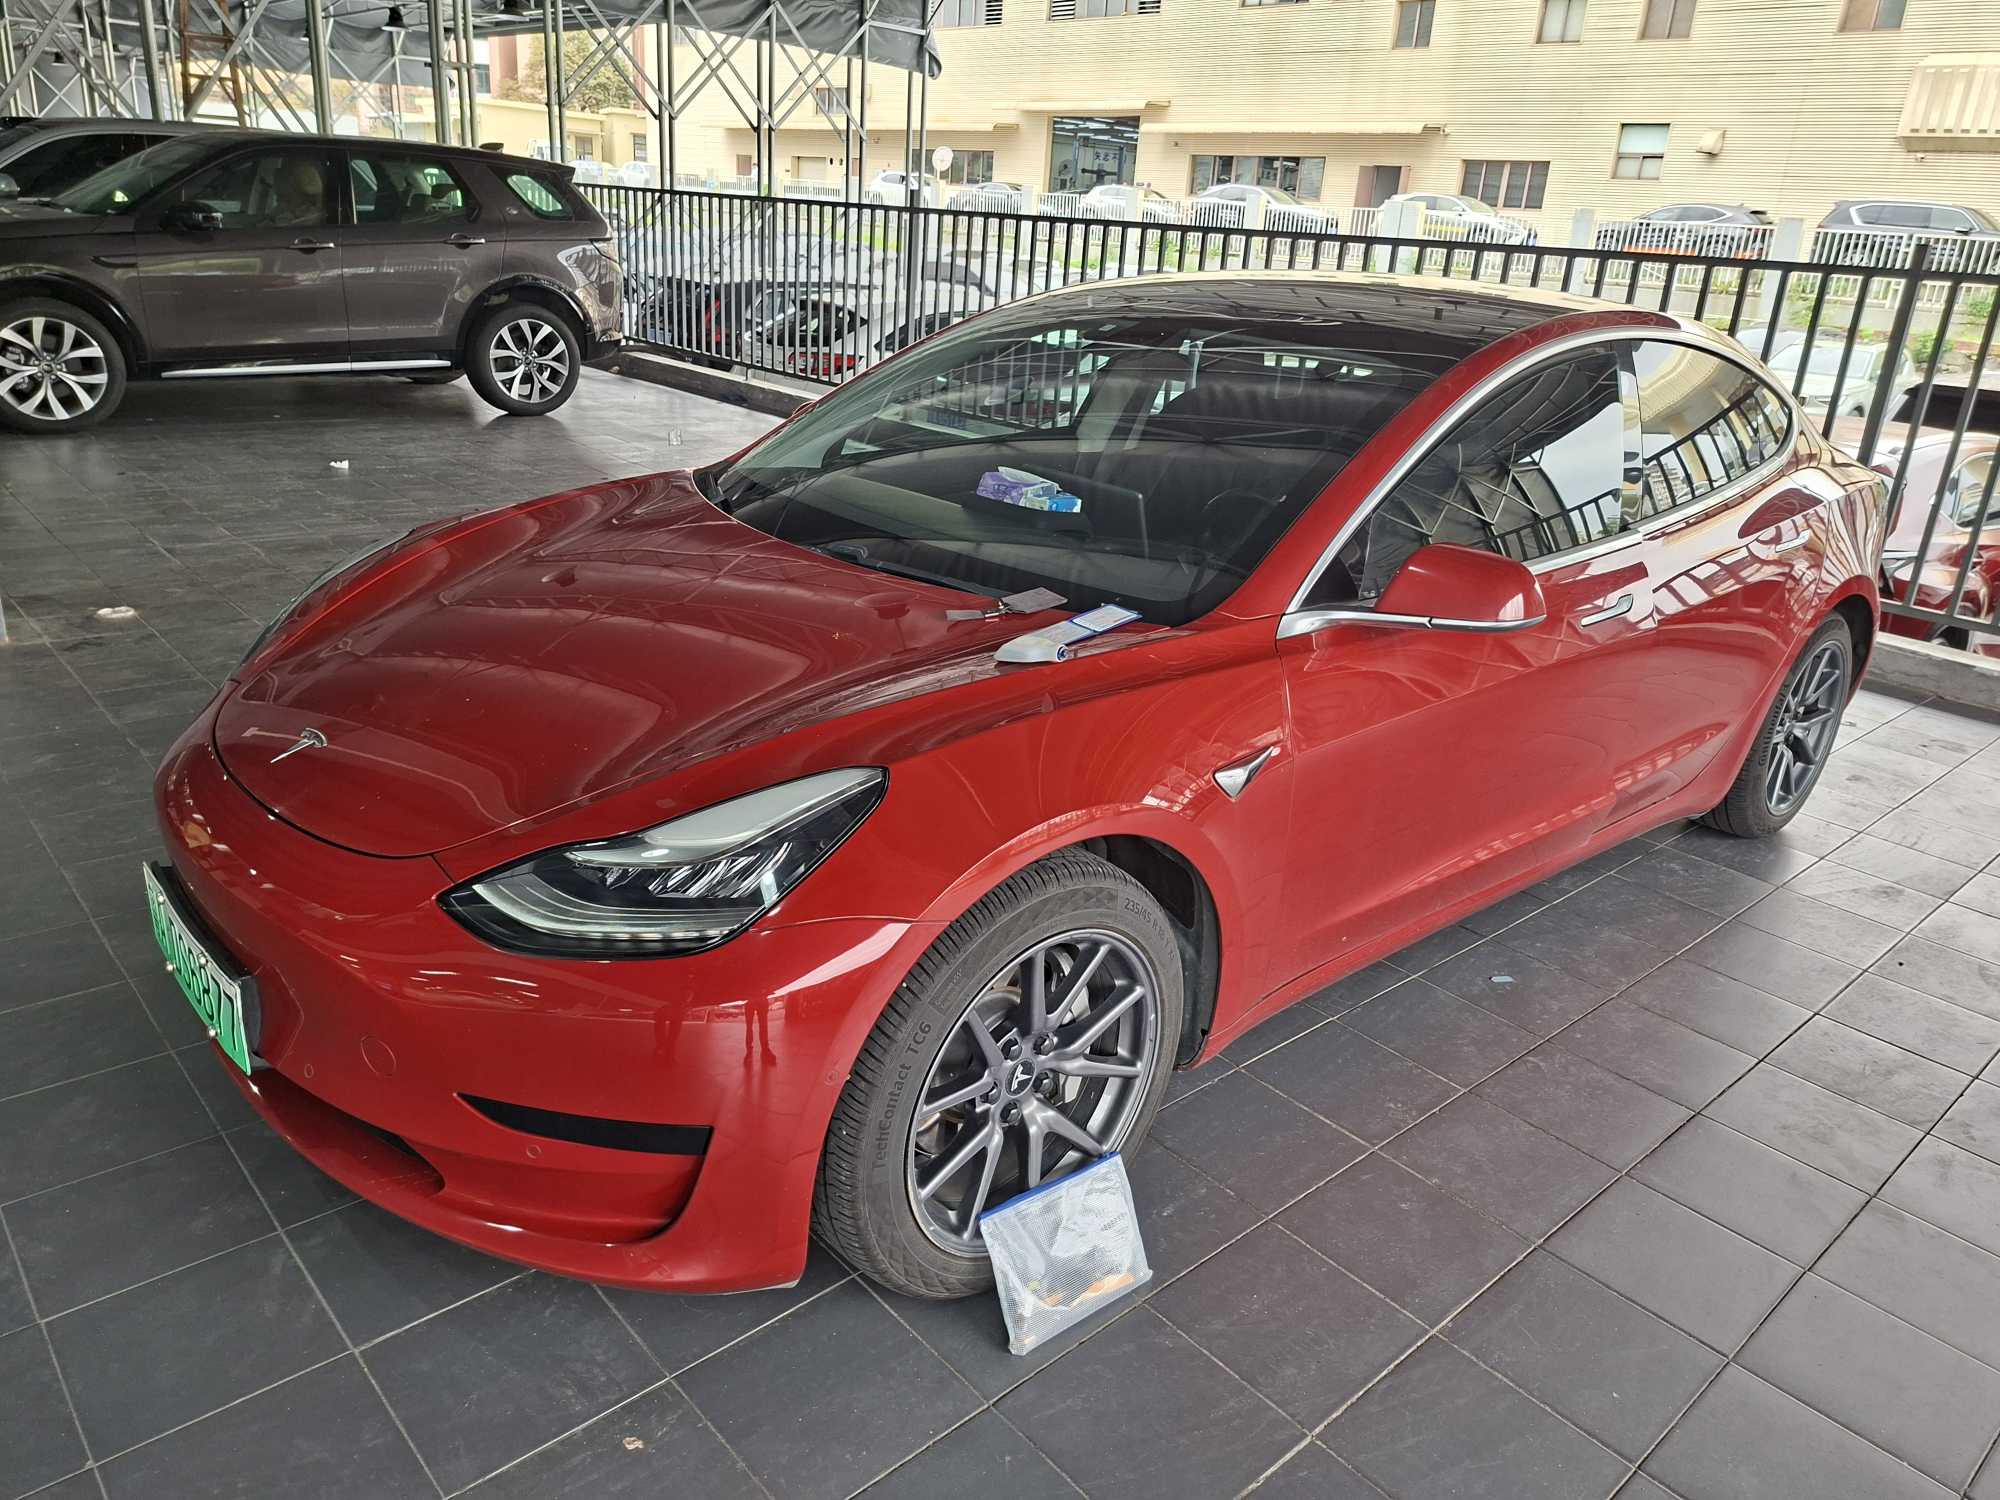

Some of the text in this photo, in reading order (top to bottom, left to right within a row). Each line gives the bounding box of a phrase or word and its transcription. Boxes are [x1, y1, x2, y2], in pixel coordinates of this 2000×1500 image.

[1124, 897, 1152, 923] 235/45
[872, 1021, 932, 1170] TechContact TC6
